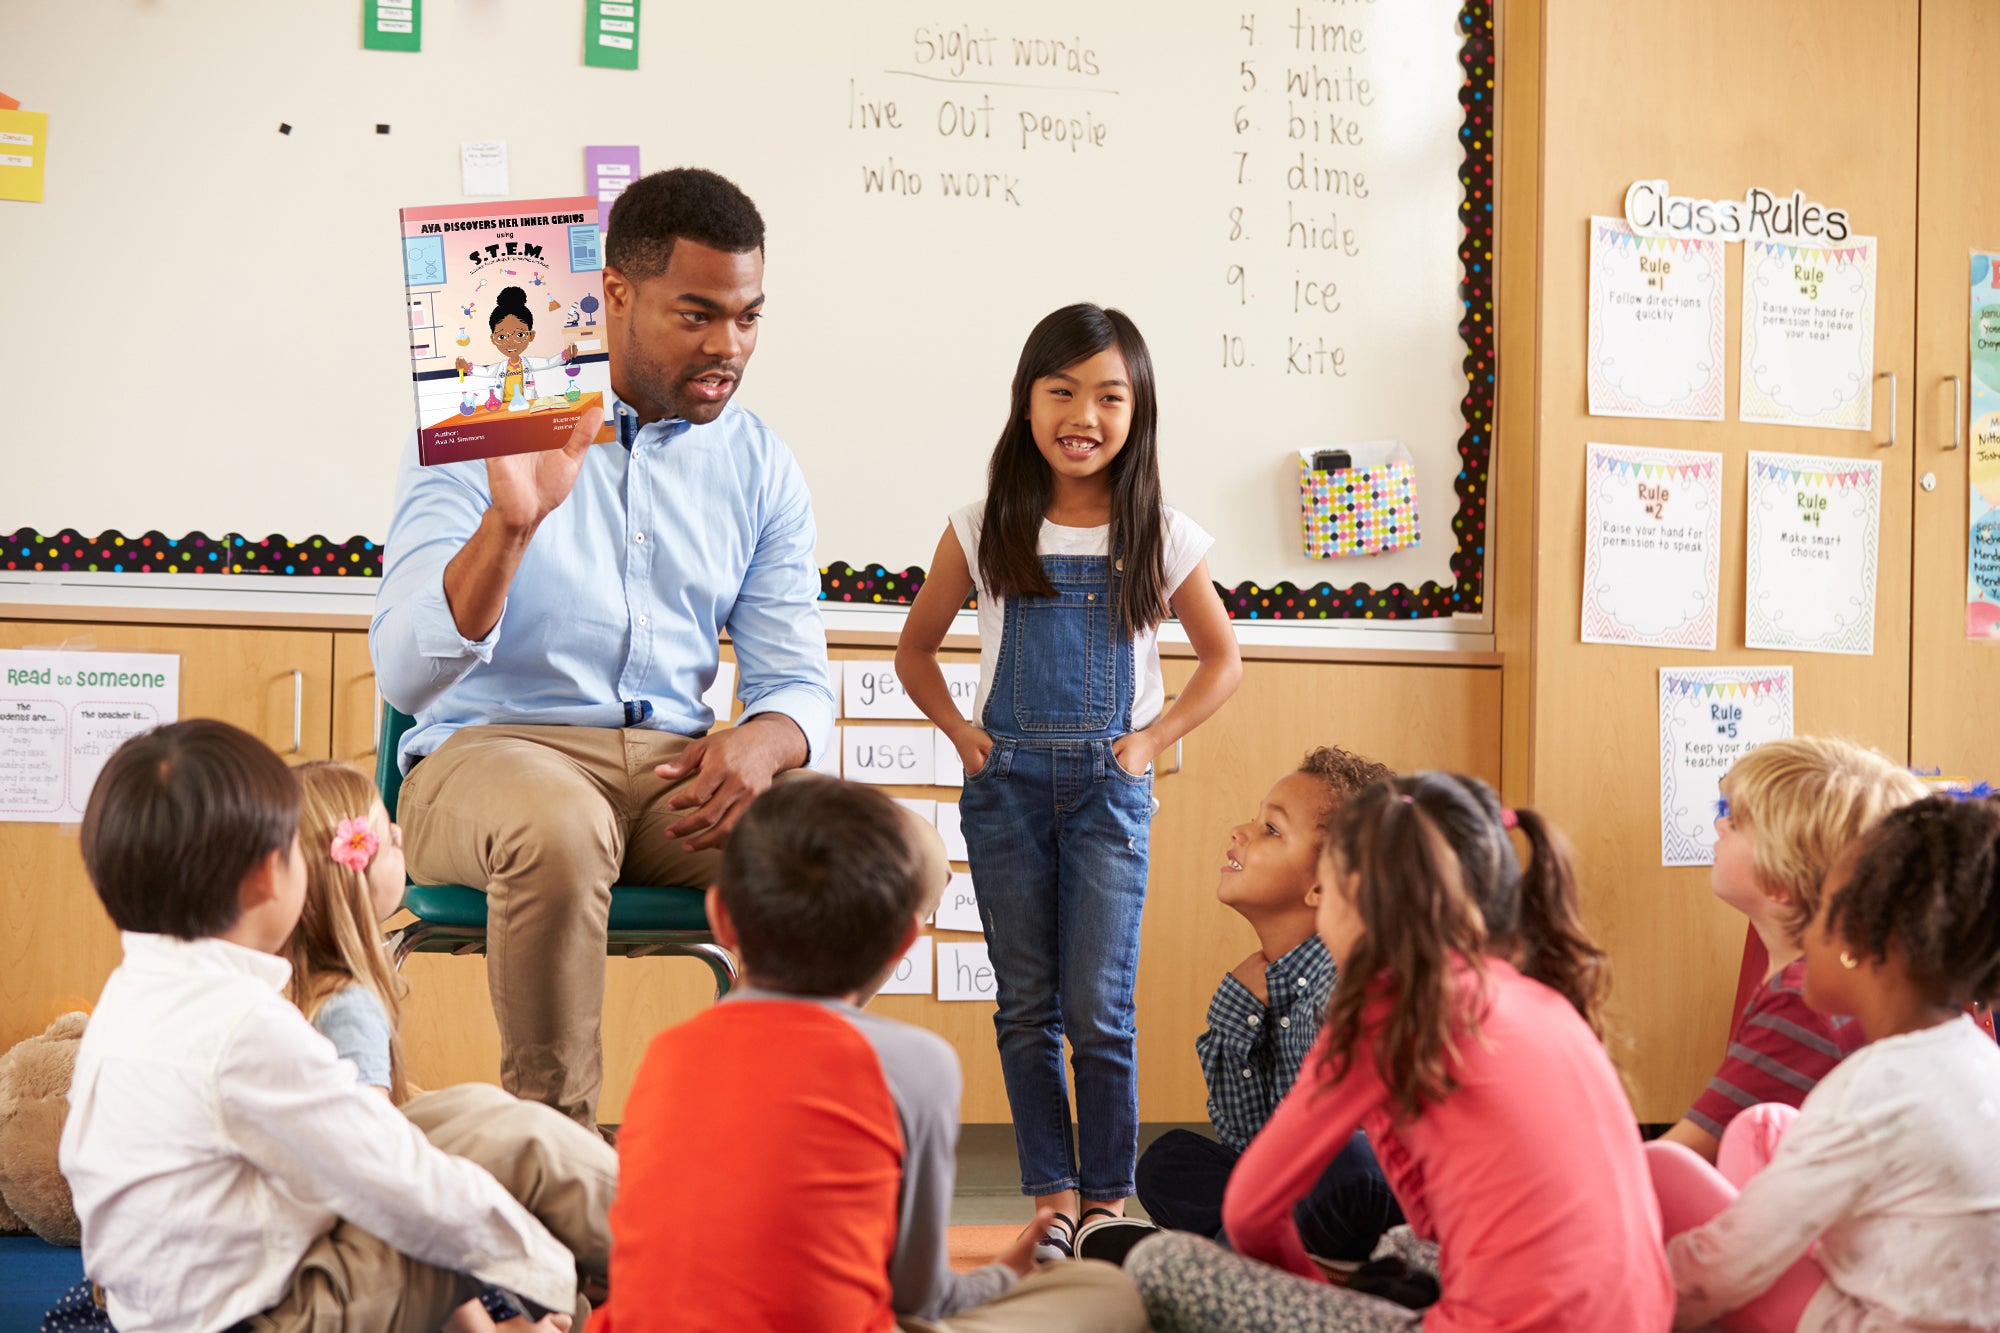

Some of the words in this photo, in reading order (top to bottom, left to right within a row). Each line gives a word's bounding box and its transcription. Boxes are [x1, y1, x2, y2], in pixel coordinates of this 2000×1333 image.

[1288, 8, 1367, 54] time
[1012, 36, 1100, 75] words
[1287, 65, 1375, 107] white
[849, 78, 903, 129] live
[1019, 111, 1107, 152] people
[1288, 100, 1364, 146] bike
[862, 156, 922, 196] who
[940, 172, 1021, 206] work
[1287, 152, 1369, 199] dime
[1631, 183, 1741, 236] Class
[1748, 188, 1848, 241] Rules
[421, 223, 442, 234] AVA
[443, 219, 497, 232] DISCOVERS
[498, 218, 519, 229] HER
[520, 215, 550, 227] INNER
[551, 213, 585, 225] GENIUS
[1229, 206, 1251, 242] 8.
[1287, 200, 1360, 257] hide
[496, 231, 514, 239] using
[469, 242, 545, 266] S.T.E.M.
[1639, 256, 1671, 274] Rule
[1794, 265, 1824, 283] Rule
[1226, 264, 1255, 305] 9.
[1294, 269, 1341, 314] ice
[1648, 276, 1664, 291] #1
[1800, 284, 1818, 300] #3
[1609, 291, 1642, 305] Follow
[1646, 295, 1701, 309] directions
[1635, 309, 1674, 323] quickly
[1762, 302, 1788, 314] Raise
[1792, 306, 1811, 317] your
[1815, 307, 1837, 318] hand
[1840, 309, 1854, 319] for
[1762, 316, 1810, 327] permission
[1814, 318, 1823, 329] to
[1827, 319, 1854, 331] leave
[1784, 329, 1804, 341] your
[1808, 332, 1831, 342] seat
[1222, 333, 1256, 369] 10.
[1286, 336, 1347, 378] kite
[434, 430, 459, 439] Author:
[457, 435, 486, 443] Simmons
[1638, 483, 1670, 502] Rule
[1797, 491, 1828, 511] Rule
[1645, 503, 1664, 520] #2
[1803, 512, 1820, 528] #4
[1603, 520, 1632, 534] Raise
[1635, 525, 1656, 538] your
[1661, 525, 1684, 538] hand
[1688, 527, 1703, 539] for
[1780, 531, 1808, 545] Make
[1812, 534, 1841, 546] smart
[1602, 537, 1655, 549] permission
[1659, 538, 1670, 550] to
[1673, 541, 1703, 553] speak
[1791, 546, 1830, 560] choices
[8, 668, 51, 686] Read
[57, 675, 72, 686] to
[860, 672, 907, 705] ge
[16, 703, 31, 711] The
[81, 710, 95, 719] The
[98, 711, 131, 720] teacher
[1711, 703, 1743, 721] Rule
[1717, 722, 1738, 738] #5
[856, 744, 917, 770] use
[1684, 741, 1714, 755] Keep
[1717, 743, 1740, 756] your
[1685, 755, 1728, 768] teacher
